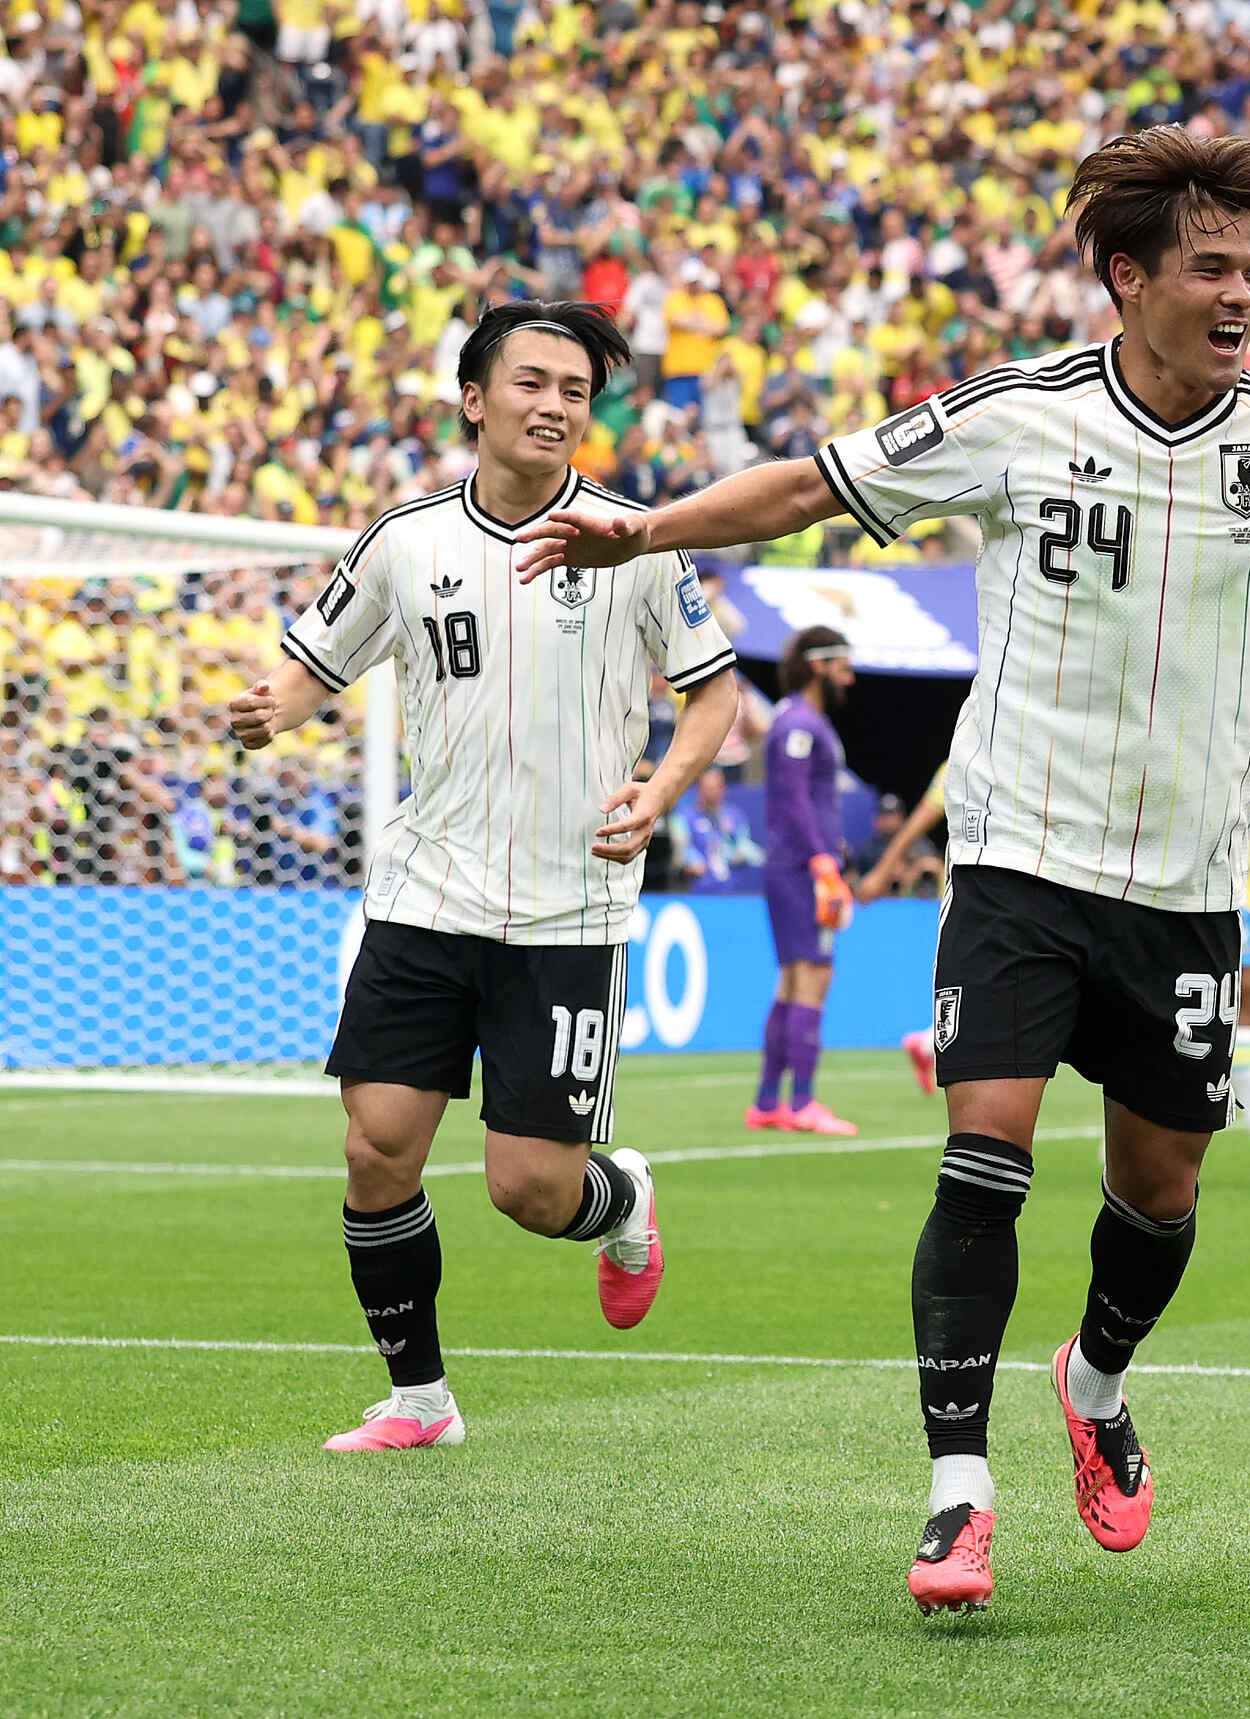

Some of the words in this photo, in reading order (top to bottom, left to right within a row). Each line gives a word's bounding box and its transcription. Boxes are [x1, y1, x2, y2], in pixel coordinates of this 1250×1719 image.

[1039, 497, 1134, 593] 24
[561, 590, 583, 600] JFA
[421, 610, 483, 683] 18
[551, 1004, 605, 1082] 18
[1173, 970, 1240, 1060] 24
[367, 1300, 414, 1318] PAN
[918, 1353, 992, 1372] JAPAN
